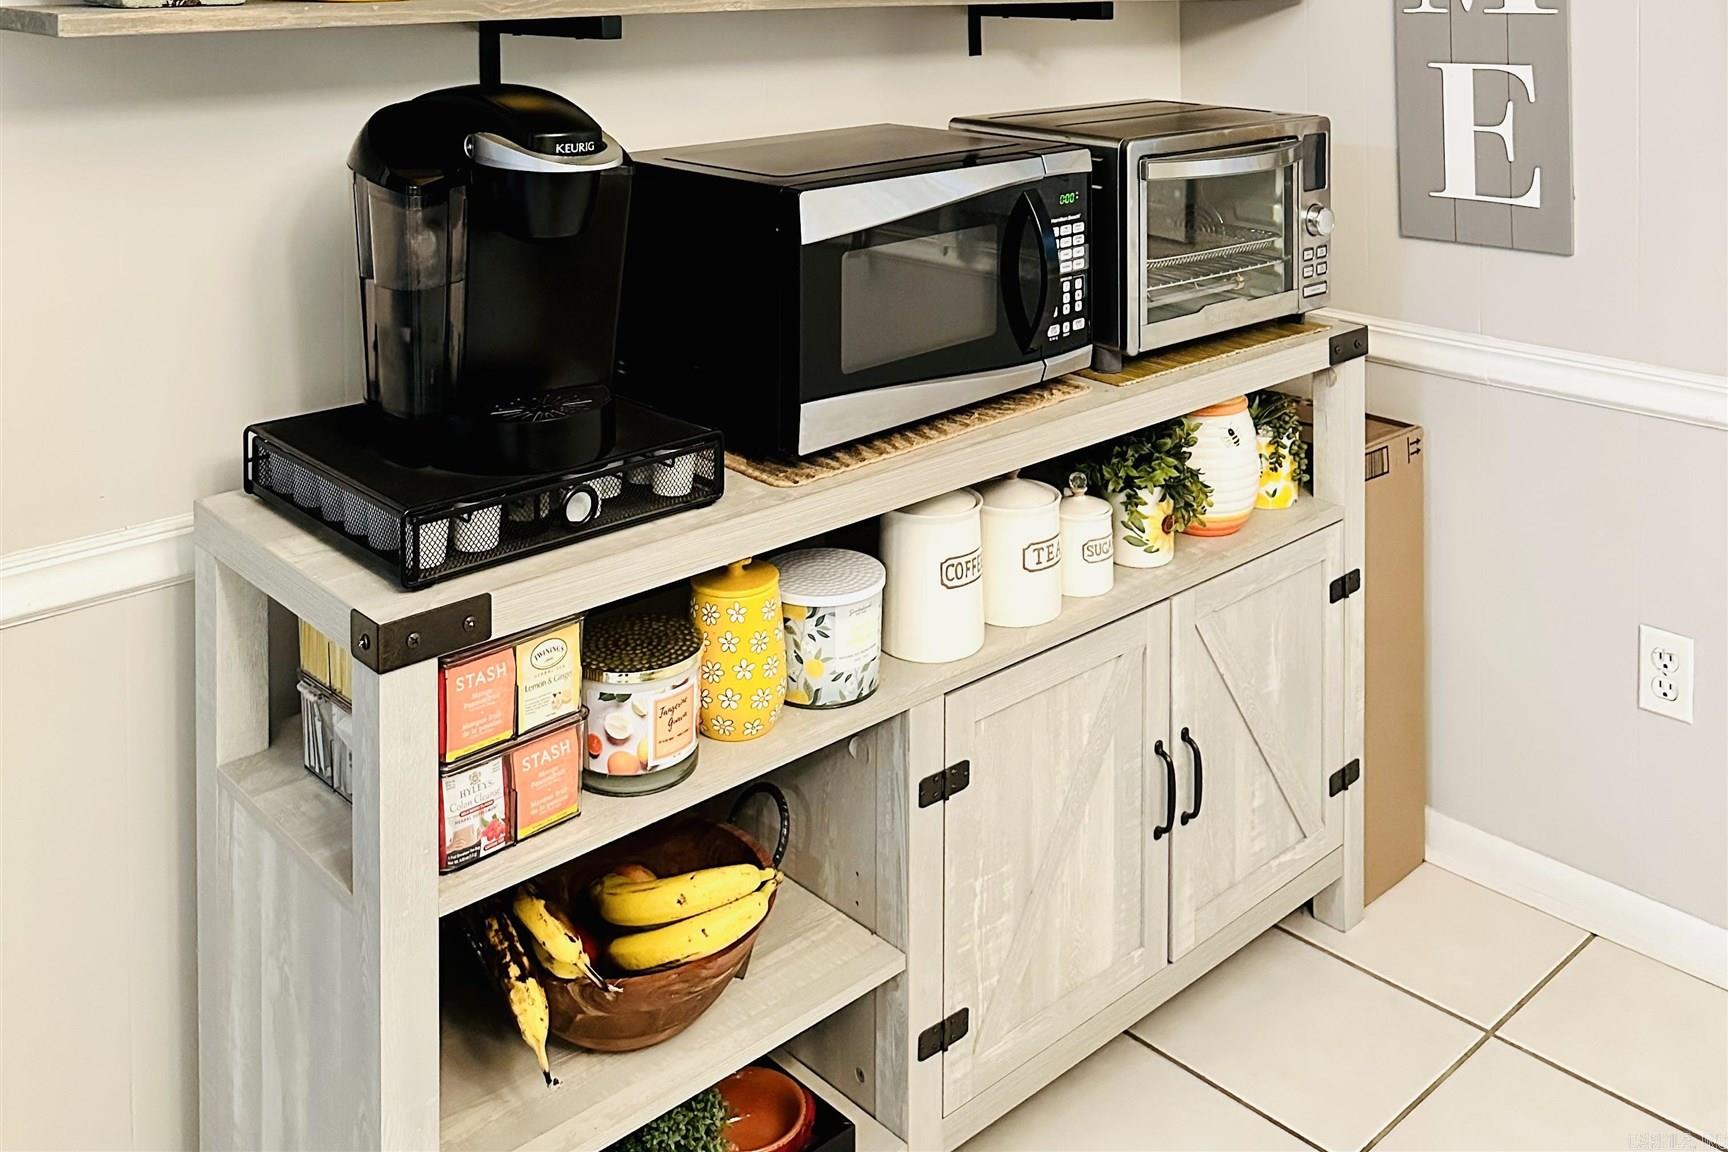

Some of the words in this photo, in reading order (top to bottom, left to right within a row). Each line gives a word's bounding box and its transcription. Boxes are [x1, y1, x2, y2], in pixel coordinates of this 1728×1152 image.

[555, 141, 595, 153] KEURIG
[1032, 538, 1061, 566] TEA
[945, 554, 982, 582] COFFE
[534, 645, 565, 662] TWININGS
[455, 662, 507, 692] STASH
[524, 680, 548, 693] Lemon
[547, 678, 553, 687] &
[553, 670, 573, 684] Ginger
[521, 739, 571, 772] STASH
[449, 798, 474, 813] Colon
[473, 788, 500, 805] Cleanse
